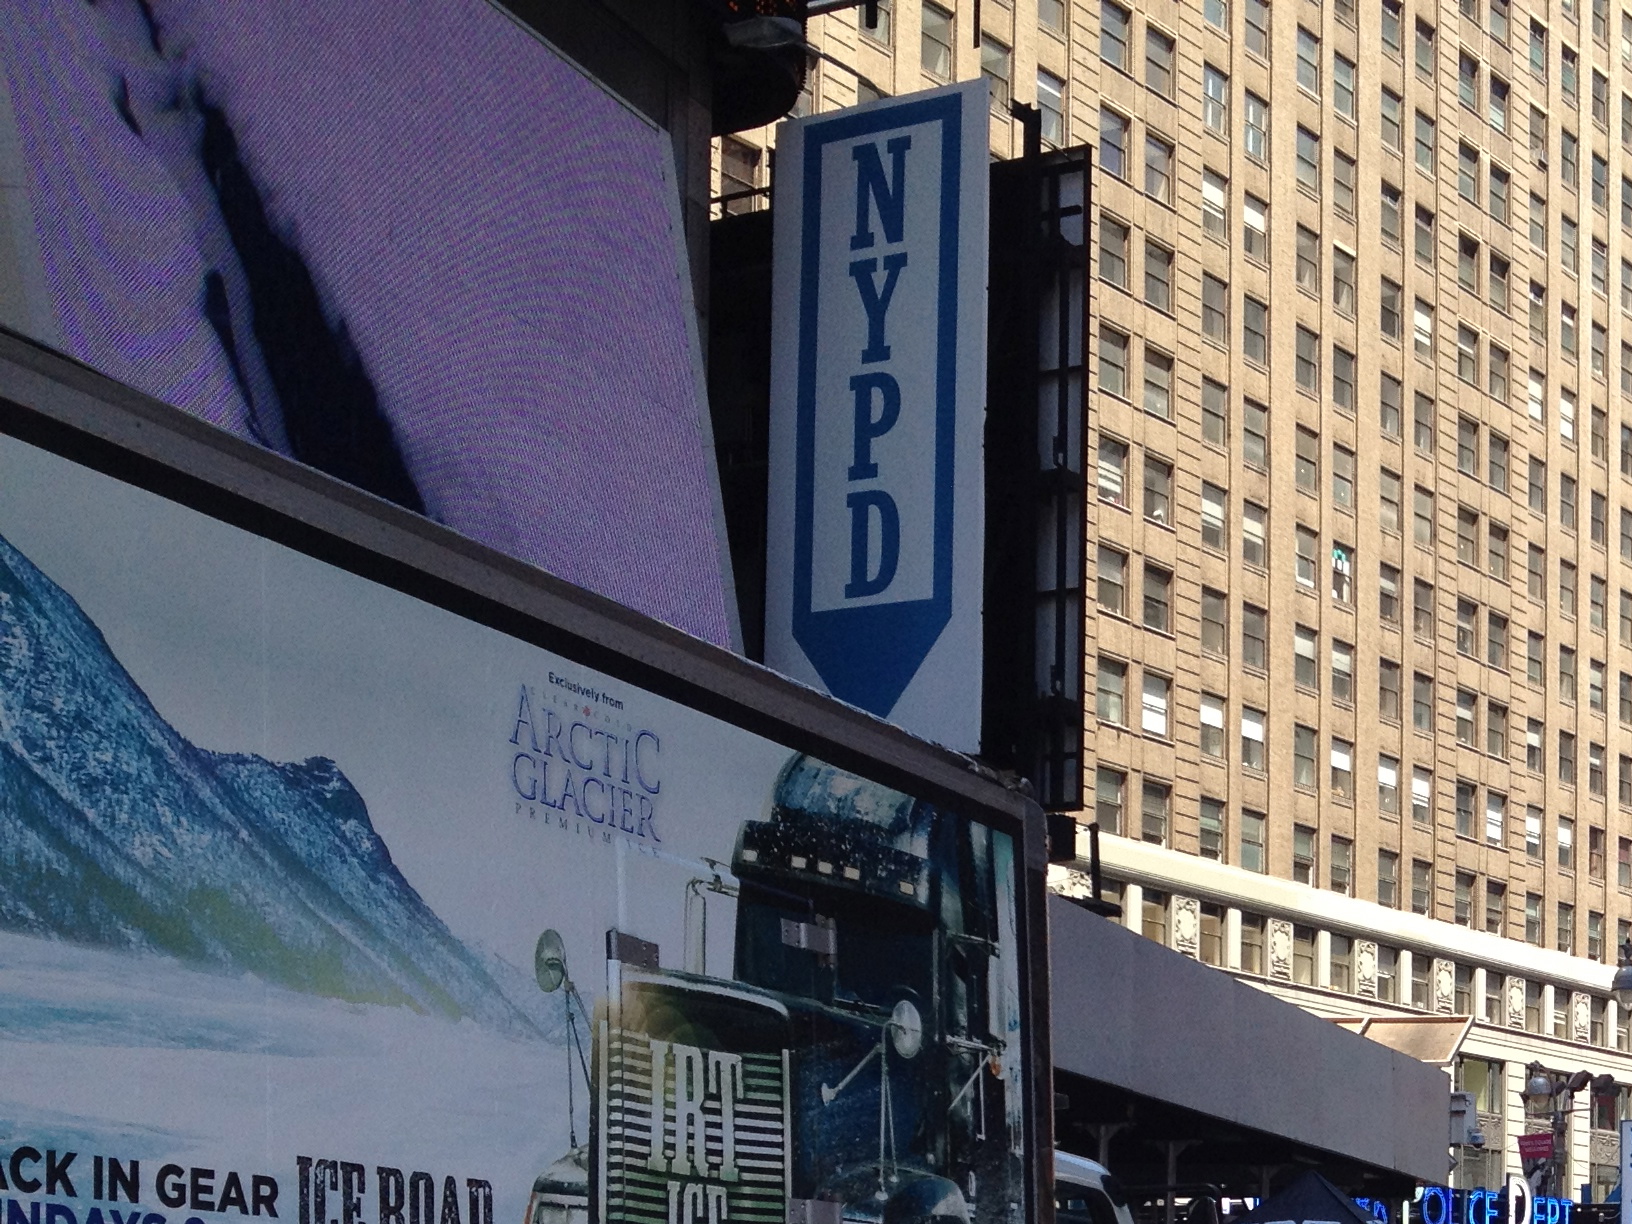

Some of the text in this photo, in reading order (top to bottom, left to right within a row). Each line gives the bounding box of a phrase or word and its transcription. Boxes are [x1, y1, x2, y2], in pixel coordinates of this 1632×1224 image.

[844, 134, 911, 600] NYPD
[548, 671, 624, 711] Exclusively from
[509, 683, 661, 795] ARCTIC
[512, 751, 662, 843] GLACIER
[515, 802, 612, 844] PREMIUM
[648, 1039, 743, 1182] IRT
[0, 1145, 279, 1218] CK IN GEAR
